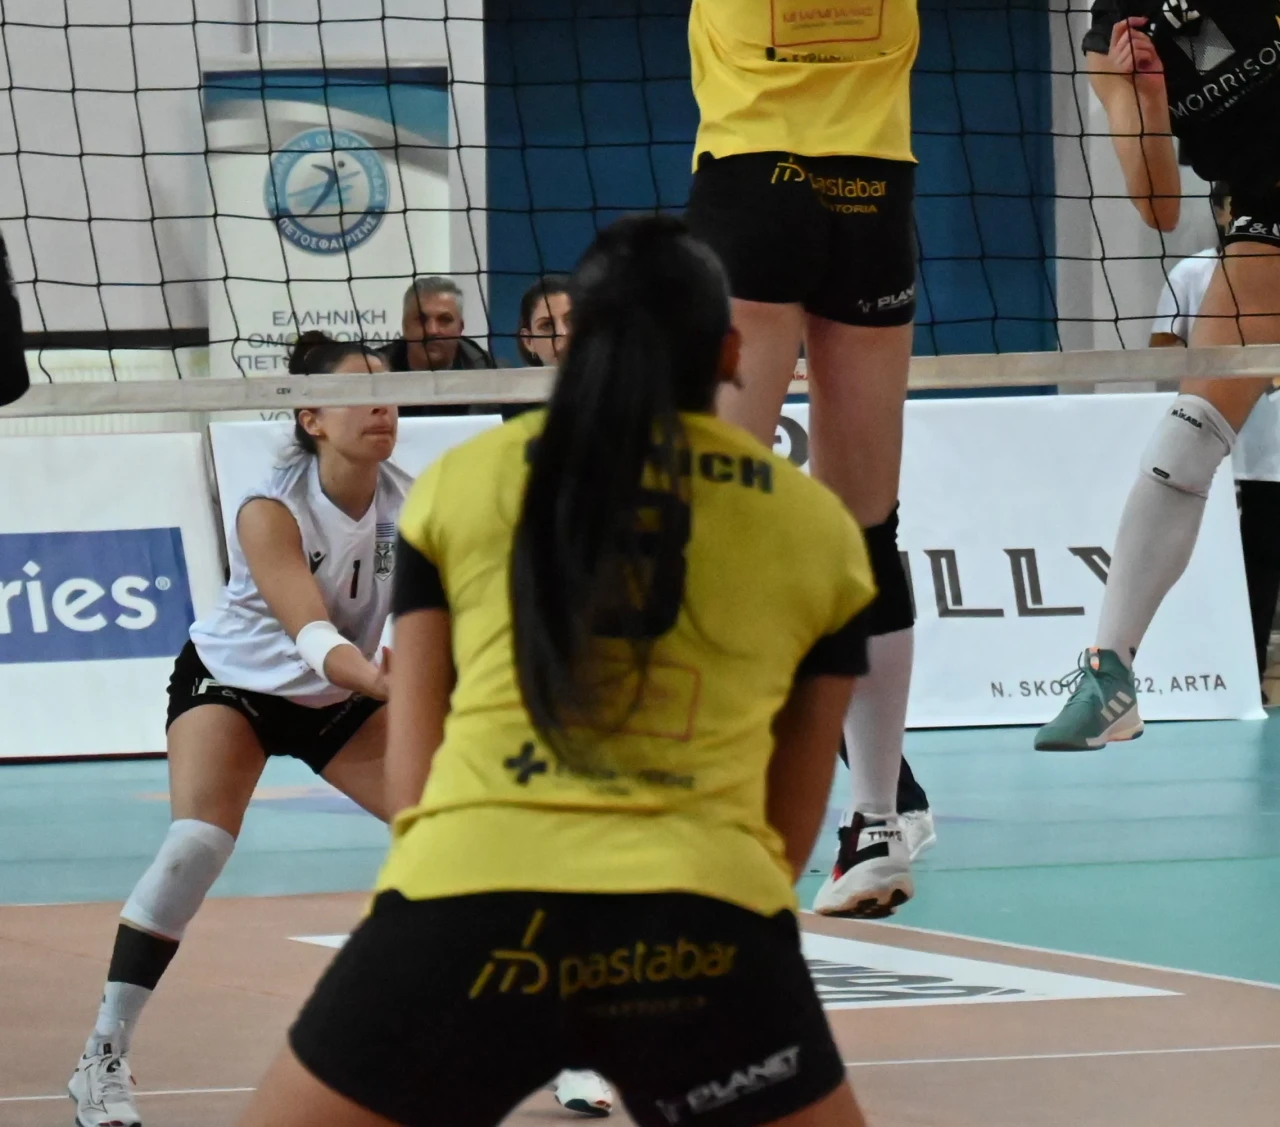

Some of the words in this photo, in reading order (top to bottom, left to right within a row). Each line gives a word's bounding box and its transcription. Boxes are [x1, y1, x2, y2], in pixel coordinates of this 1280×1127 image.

[272, 310, 386, 326] ΕΛΛΗΝΙΚΗ
[350, 559, 361, 599] 1
[990, 681, 1012, 698] N.
[1170, 674, 1228, 692] ARTA
[559, 936, 739, 1000] pastabar
